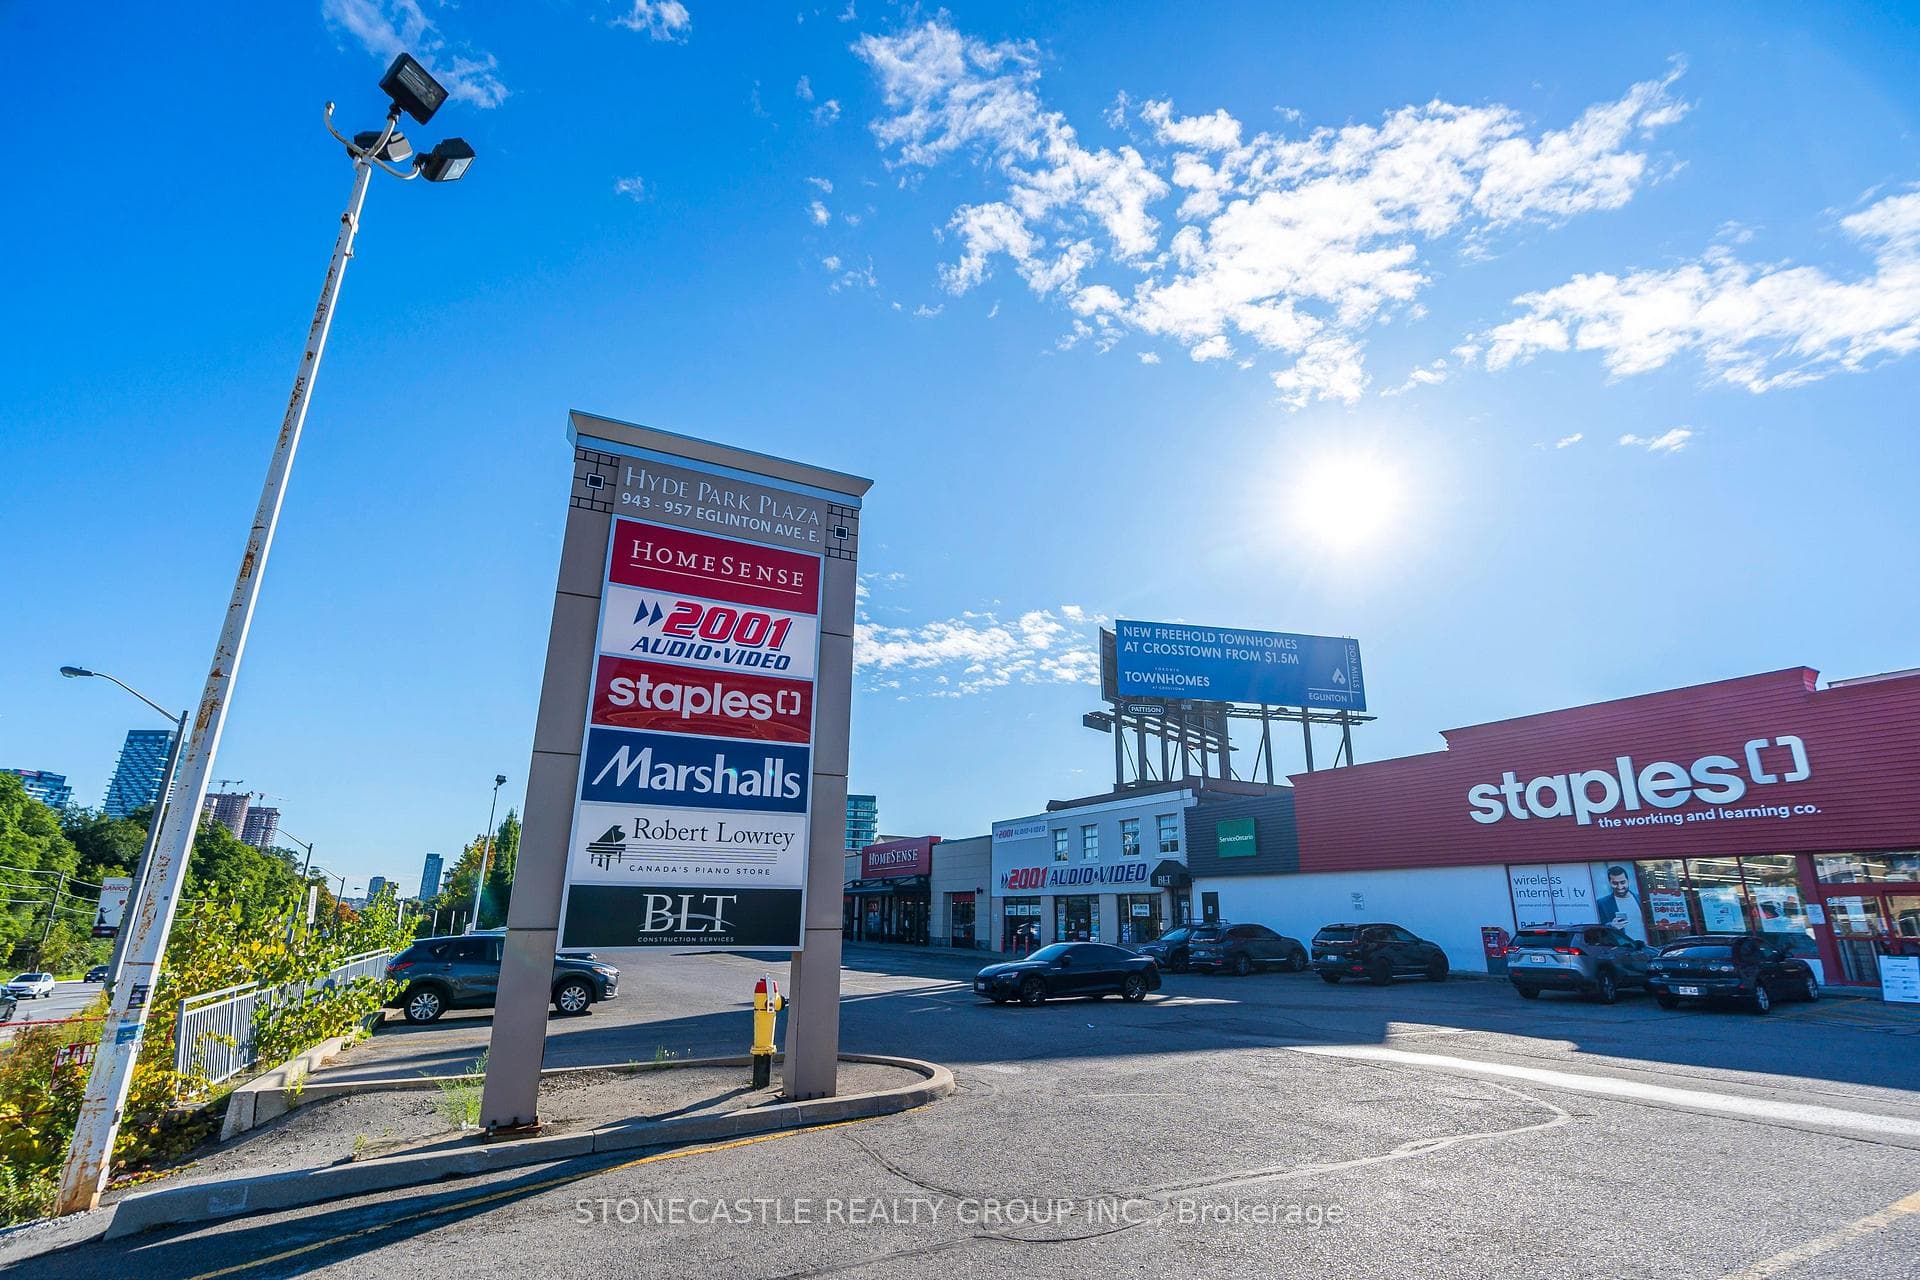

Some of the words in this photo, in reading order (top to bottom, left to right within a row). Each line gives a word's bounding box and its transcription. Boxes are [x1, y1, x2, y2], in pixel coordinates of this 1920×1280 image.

[625, 467, 689, 498] HYDE
[698, 482, 751, 512] PARK
[759, 495, 820, 526] PLAZA
[621, 492, 651, 509] 943
[664, 501, 692, 516] 957
[696, 508, 771, 533] EGLINTON
[774, 522, 805, 540] AVE.
[809, 530, 820, 543] E.
[631, 540, 804, 588] HOMESENSE
[661, 600, 793, 651] 2001
[1123, 626, 1151, 639] NEW
[1155, 628, 1215, 643] FREEHOLD
[1218, 633, 1298, 650] TOWNHOMES
[1124, 642, 1139, 652] AT
[1143, 642, 1222, 659] CROSSTOWN
[1226, 648, 1261, 662] FROM
[1265, 651, 1299, 665] $1.5M
[1348, 645, 1357, 664] DON
[1124, 671, 1210, 687] TOWNHOMES
[1351, 665, 1360, 688] MILLS
[607, 674, 773, 720] staples
[1308, 692, 1348, 703] EGLINTON
[592, 745, 801, 799] Marshalls
[1468, 754, 1748, 826] staples
[1598, 817, 1622, 828] the
[1624, 812, 1684, 826] working
[1686, 808, 1716, 822] and
[1720, 804, 1789, 819] learning
[1793, 804, 1821, 815] co.
[631, 817, 708, 843] Robert
[716, 822, 796, 852] Lowrey
[868, 849, 918, 866] HOMESENSE
[629, 865, 688, 873] CANADA'S
[695, 867, 730, 875] PIANO
[736, 868, 770, 876] STORE
[1008, 866, 1048, 890] 2001
[1157, 875, 1171, 885] BLT
[1513, 874, 1562, 885] wireless
[1515, 887, 1565, 898] internet
[1573, 887, 1586, 898] tv
[639, 893, 737, 933] BLT
